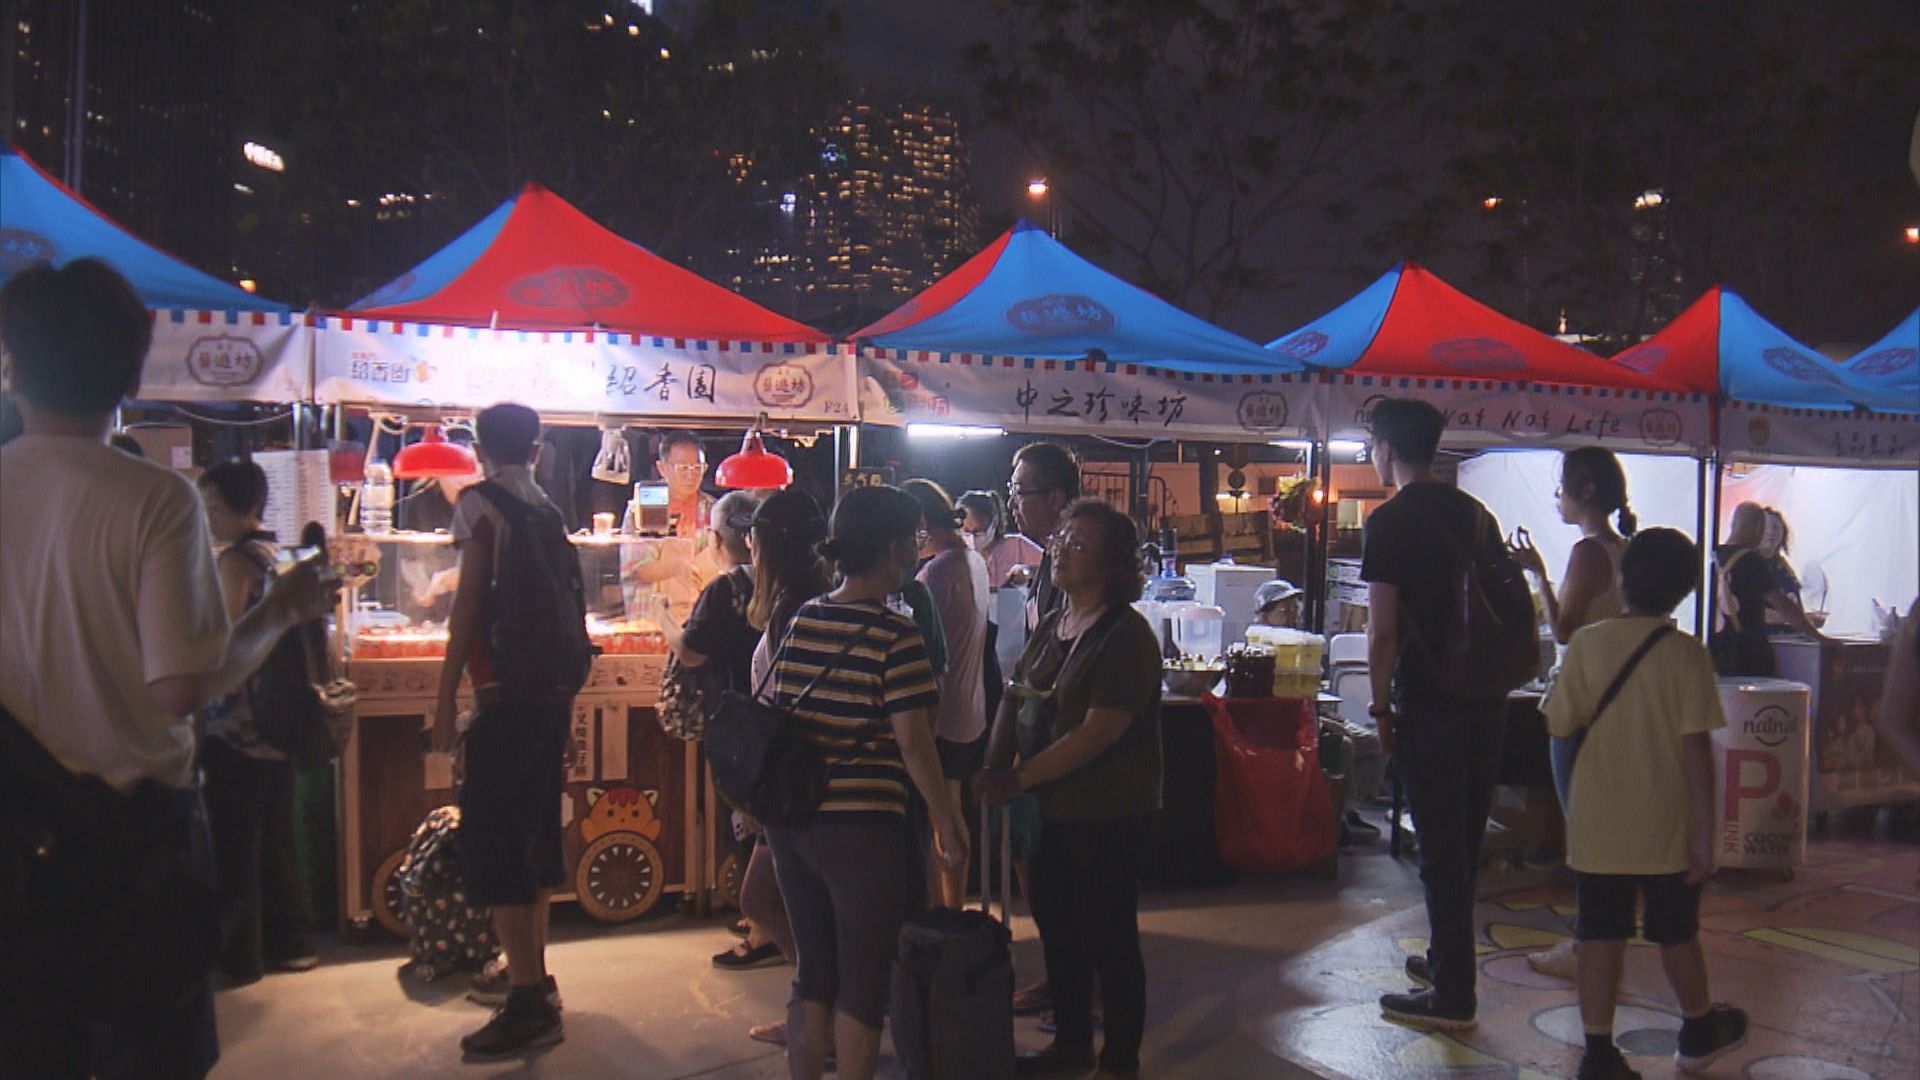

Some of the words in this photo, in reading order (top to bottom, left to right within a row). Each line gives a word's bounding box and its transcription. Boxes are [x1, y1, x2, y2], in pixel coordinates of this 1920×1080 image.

[1016, 378, 1188, 428] 中之珍味坊
[1501, 410, 1550, 429] Nat
[1565, 413, 1621, 440] Life
